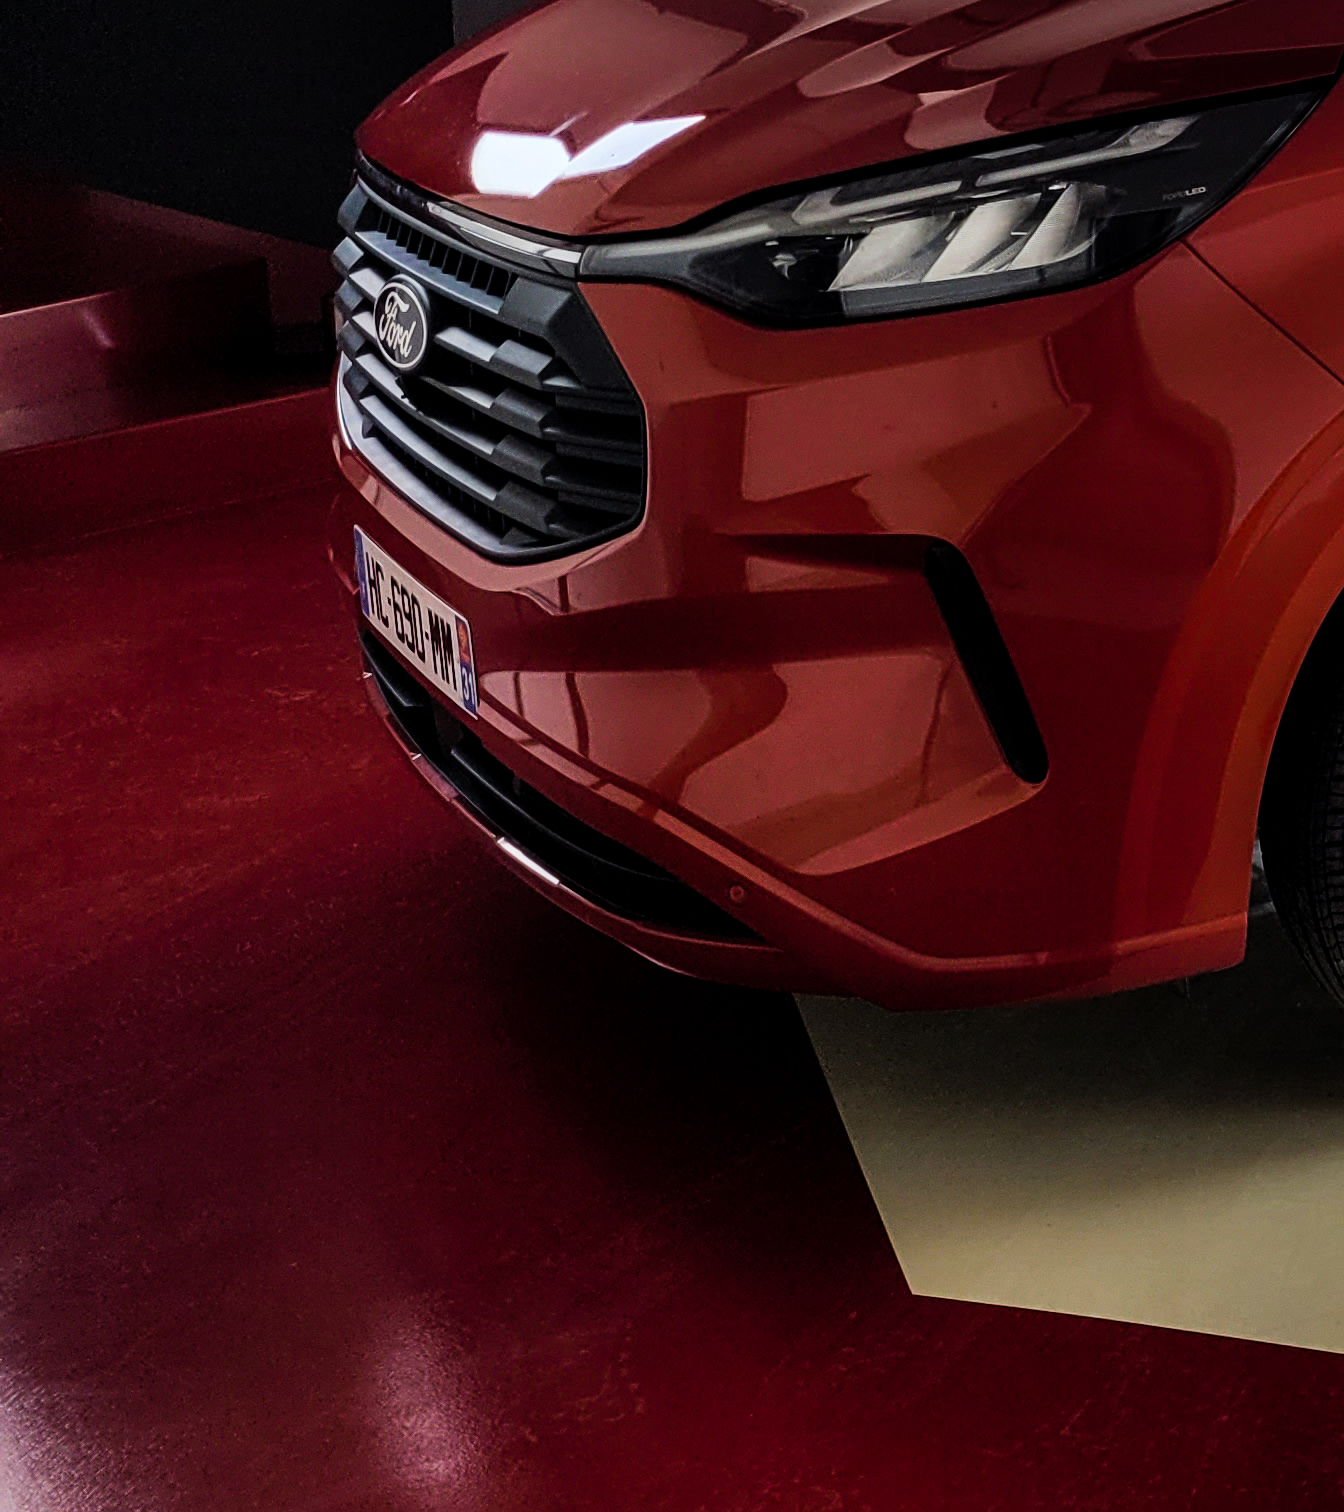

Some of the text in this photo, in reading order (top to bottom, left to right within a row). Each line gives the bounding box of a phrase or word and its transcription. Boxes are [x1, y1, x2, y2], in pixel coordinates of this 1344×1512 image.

[378, 291, 417, 358] Ford
[365, 551, 458, 692] HC-690-MM
[461, 666, 477, 705] 31
